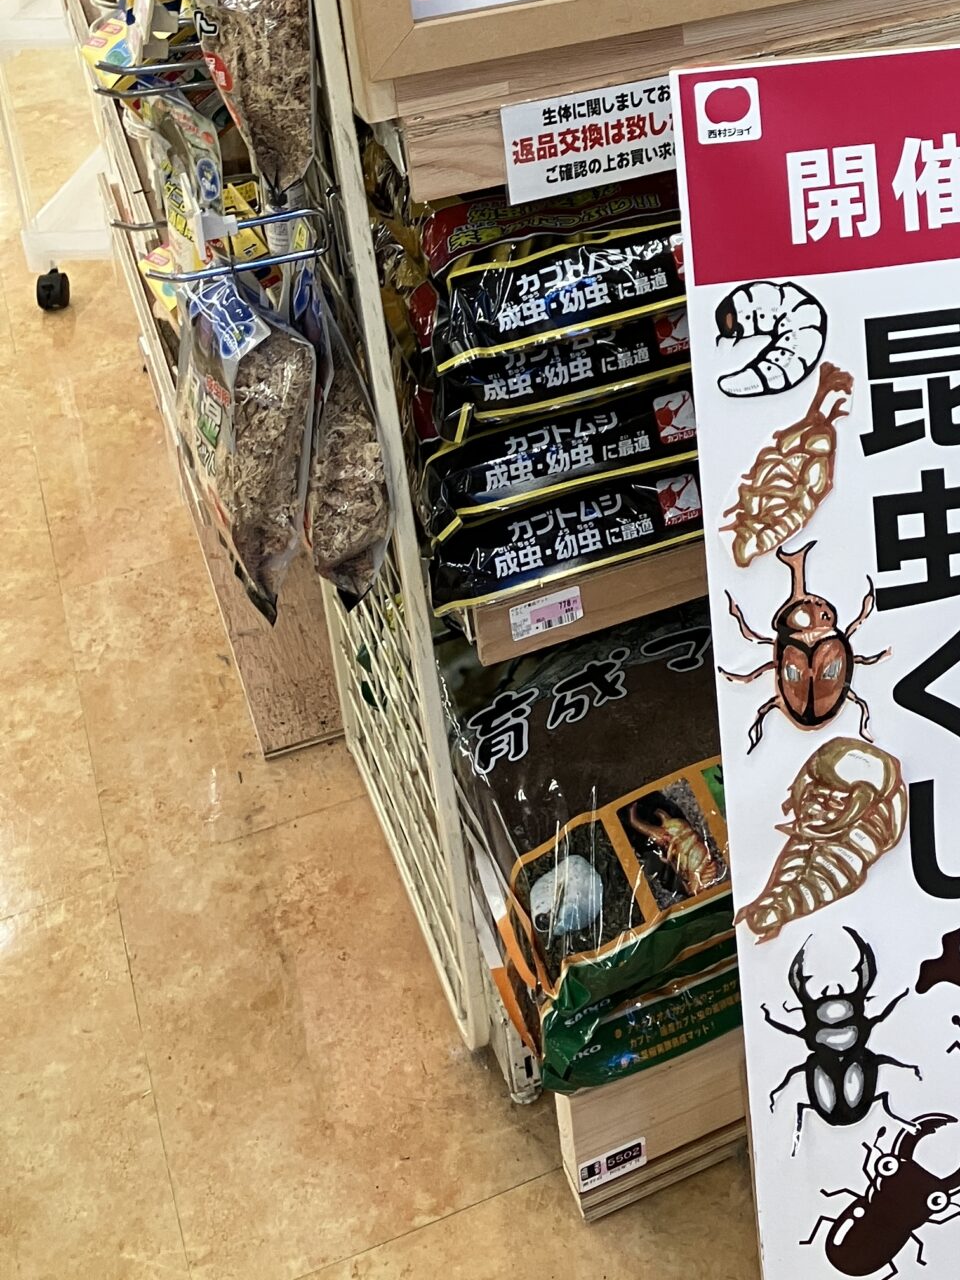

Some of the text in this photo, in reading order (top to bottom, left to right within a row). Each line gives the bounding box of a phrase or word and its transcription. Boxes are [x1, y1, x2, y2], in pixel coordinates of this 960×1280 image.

[541, 84, 671, 127] 生体に関しましてお
[511, 110, 674, 166] 返品交換は致し
[707, 125, 753, 139] 西村ジョイ
[545, 141, 676, 185] ご確認の上お買い求
[504, 411, 618, 455] カブトムシ
[507, 493, 623, 543] カブトムシ
